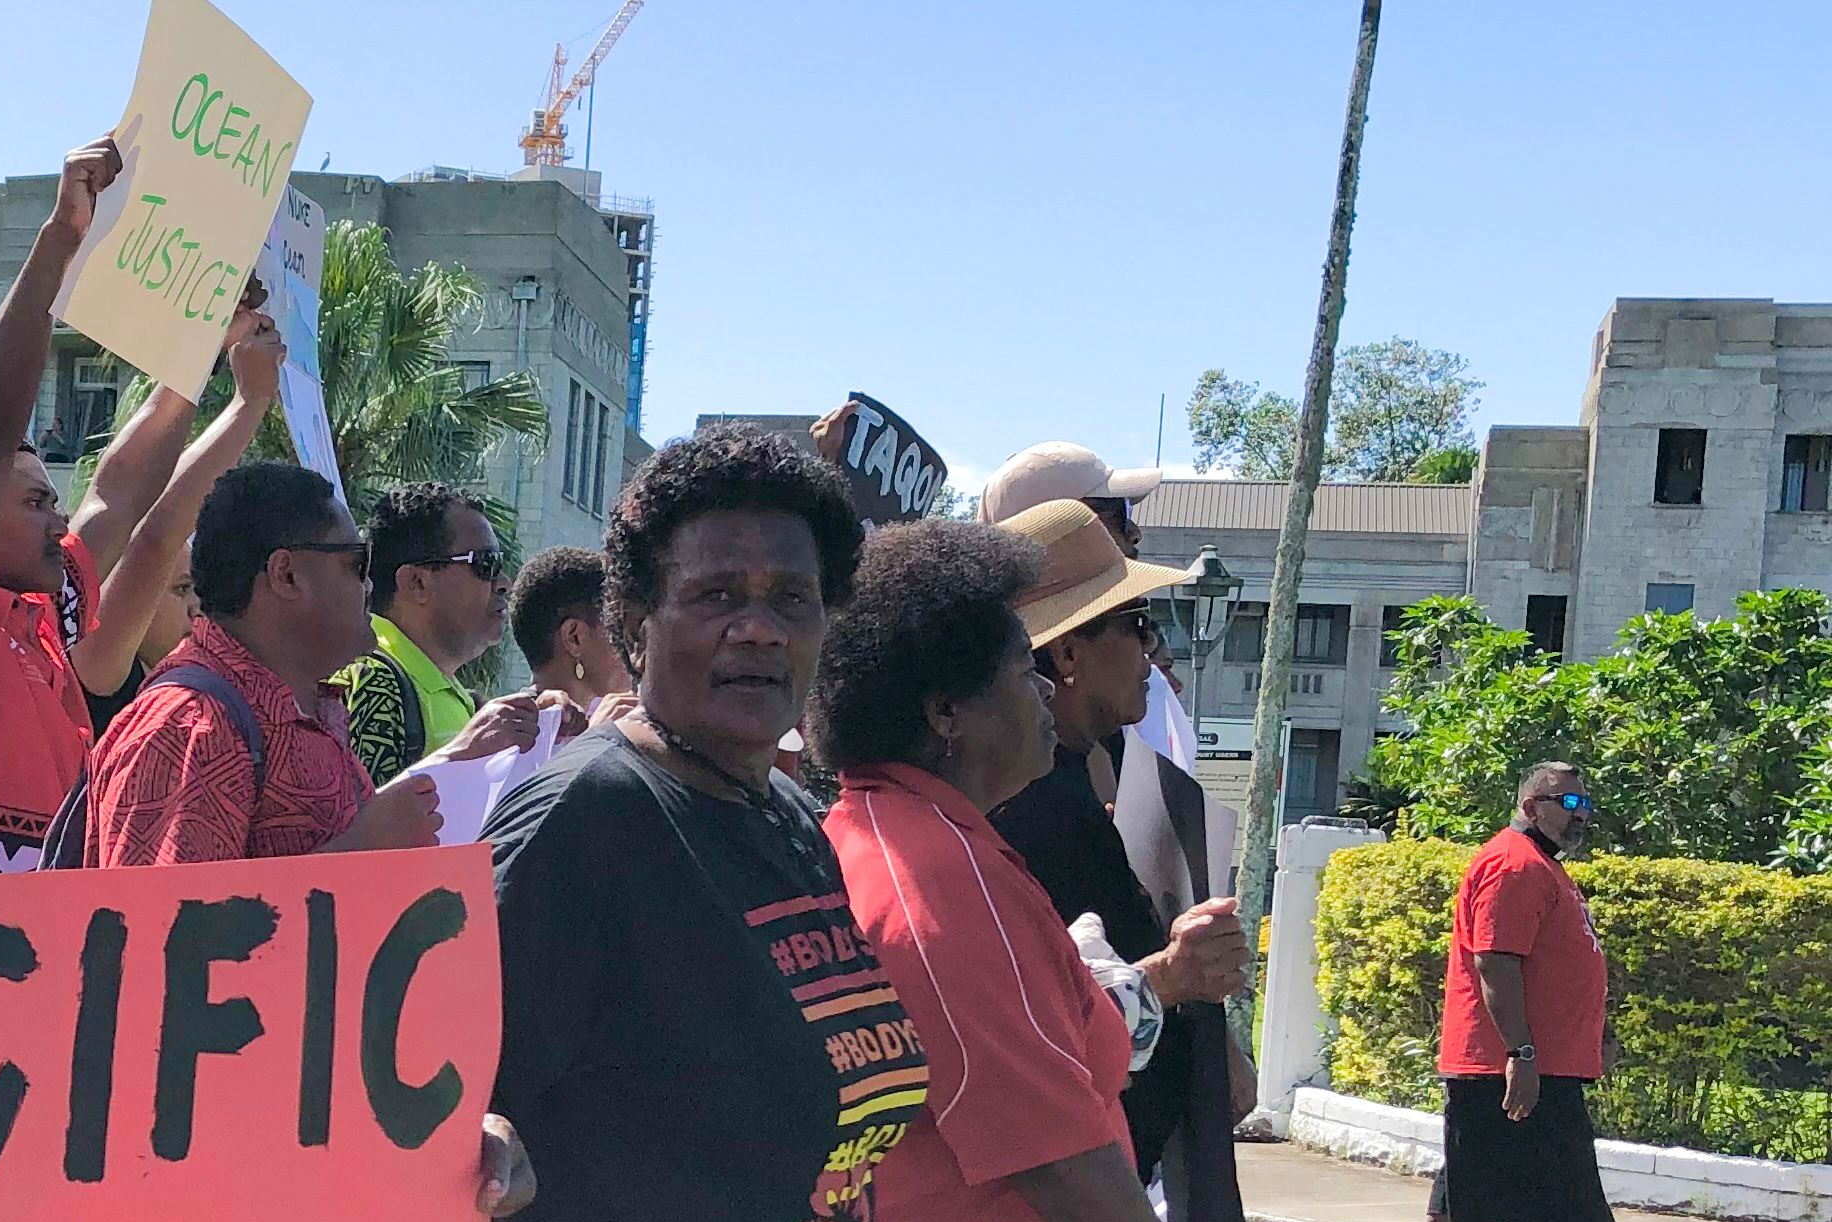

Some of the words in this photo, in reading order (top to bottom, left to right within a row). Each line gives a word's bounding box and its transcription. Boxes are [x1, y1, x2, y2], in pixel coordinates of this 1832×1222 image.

[171, 73, 293, 199] OCEAN
[117, 194, 251, 328] JUSTICE!
[846, 402, 943, 519] TAQO
